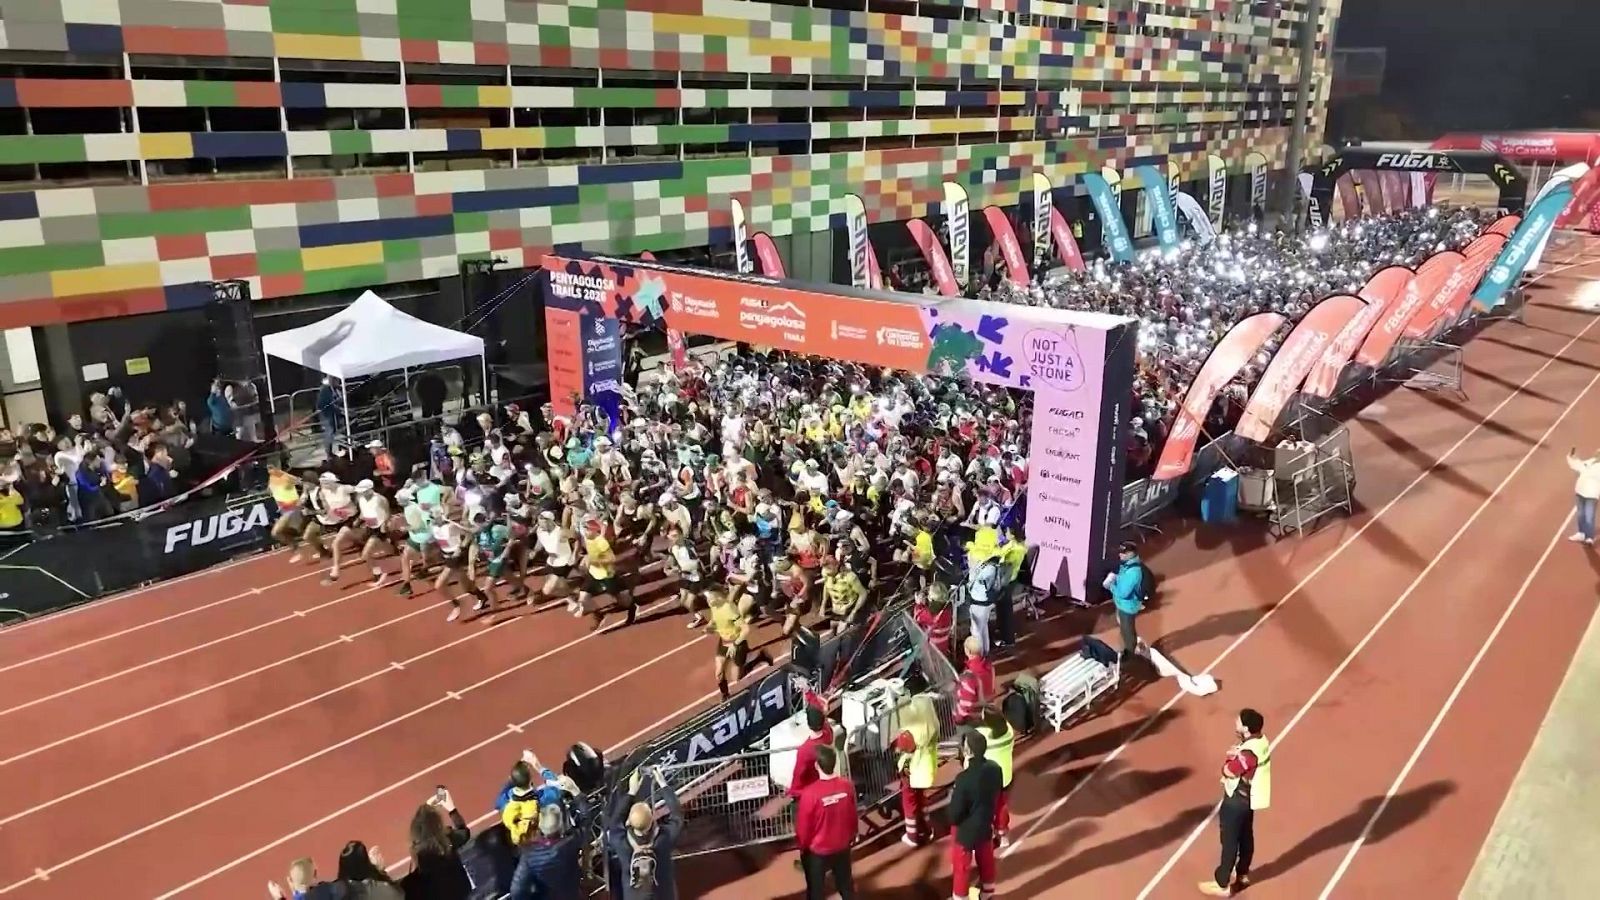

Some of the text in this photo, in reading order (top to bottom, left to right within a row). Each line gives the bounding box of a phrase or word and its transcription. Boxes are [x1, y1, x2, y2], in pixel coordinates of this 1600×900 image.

[1376, 152, 1433, 168] FUGA
[550, 270, 615, 291] PENYAGOLOSA
[550, 283, 608, 303] TRAILS 2026
[1032, 338, 1058, 352] NOT
[1031, 352, 1074, 368] JUST A
[1030, 365, 1073, 382] STONE
[163, 503, 270, 553] FUGA
